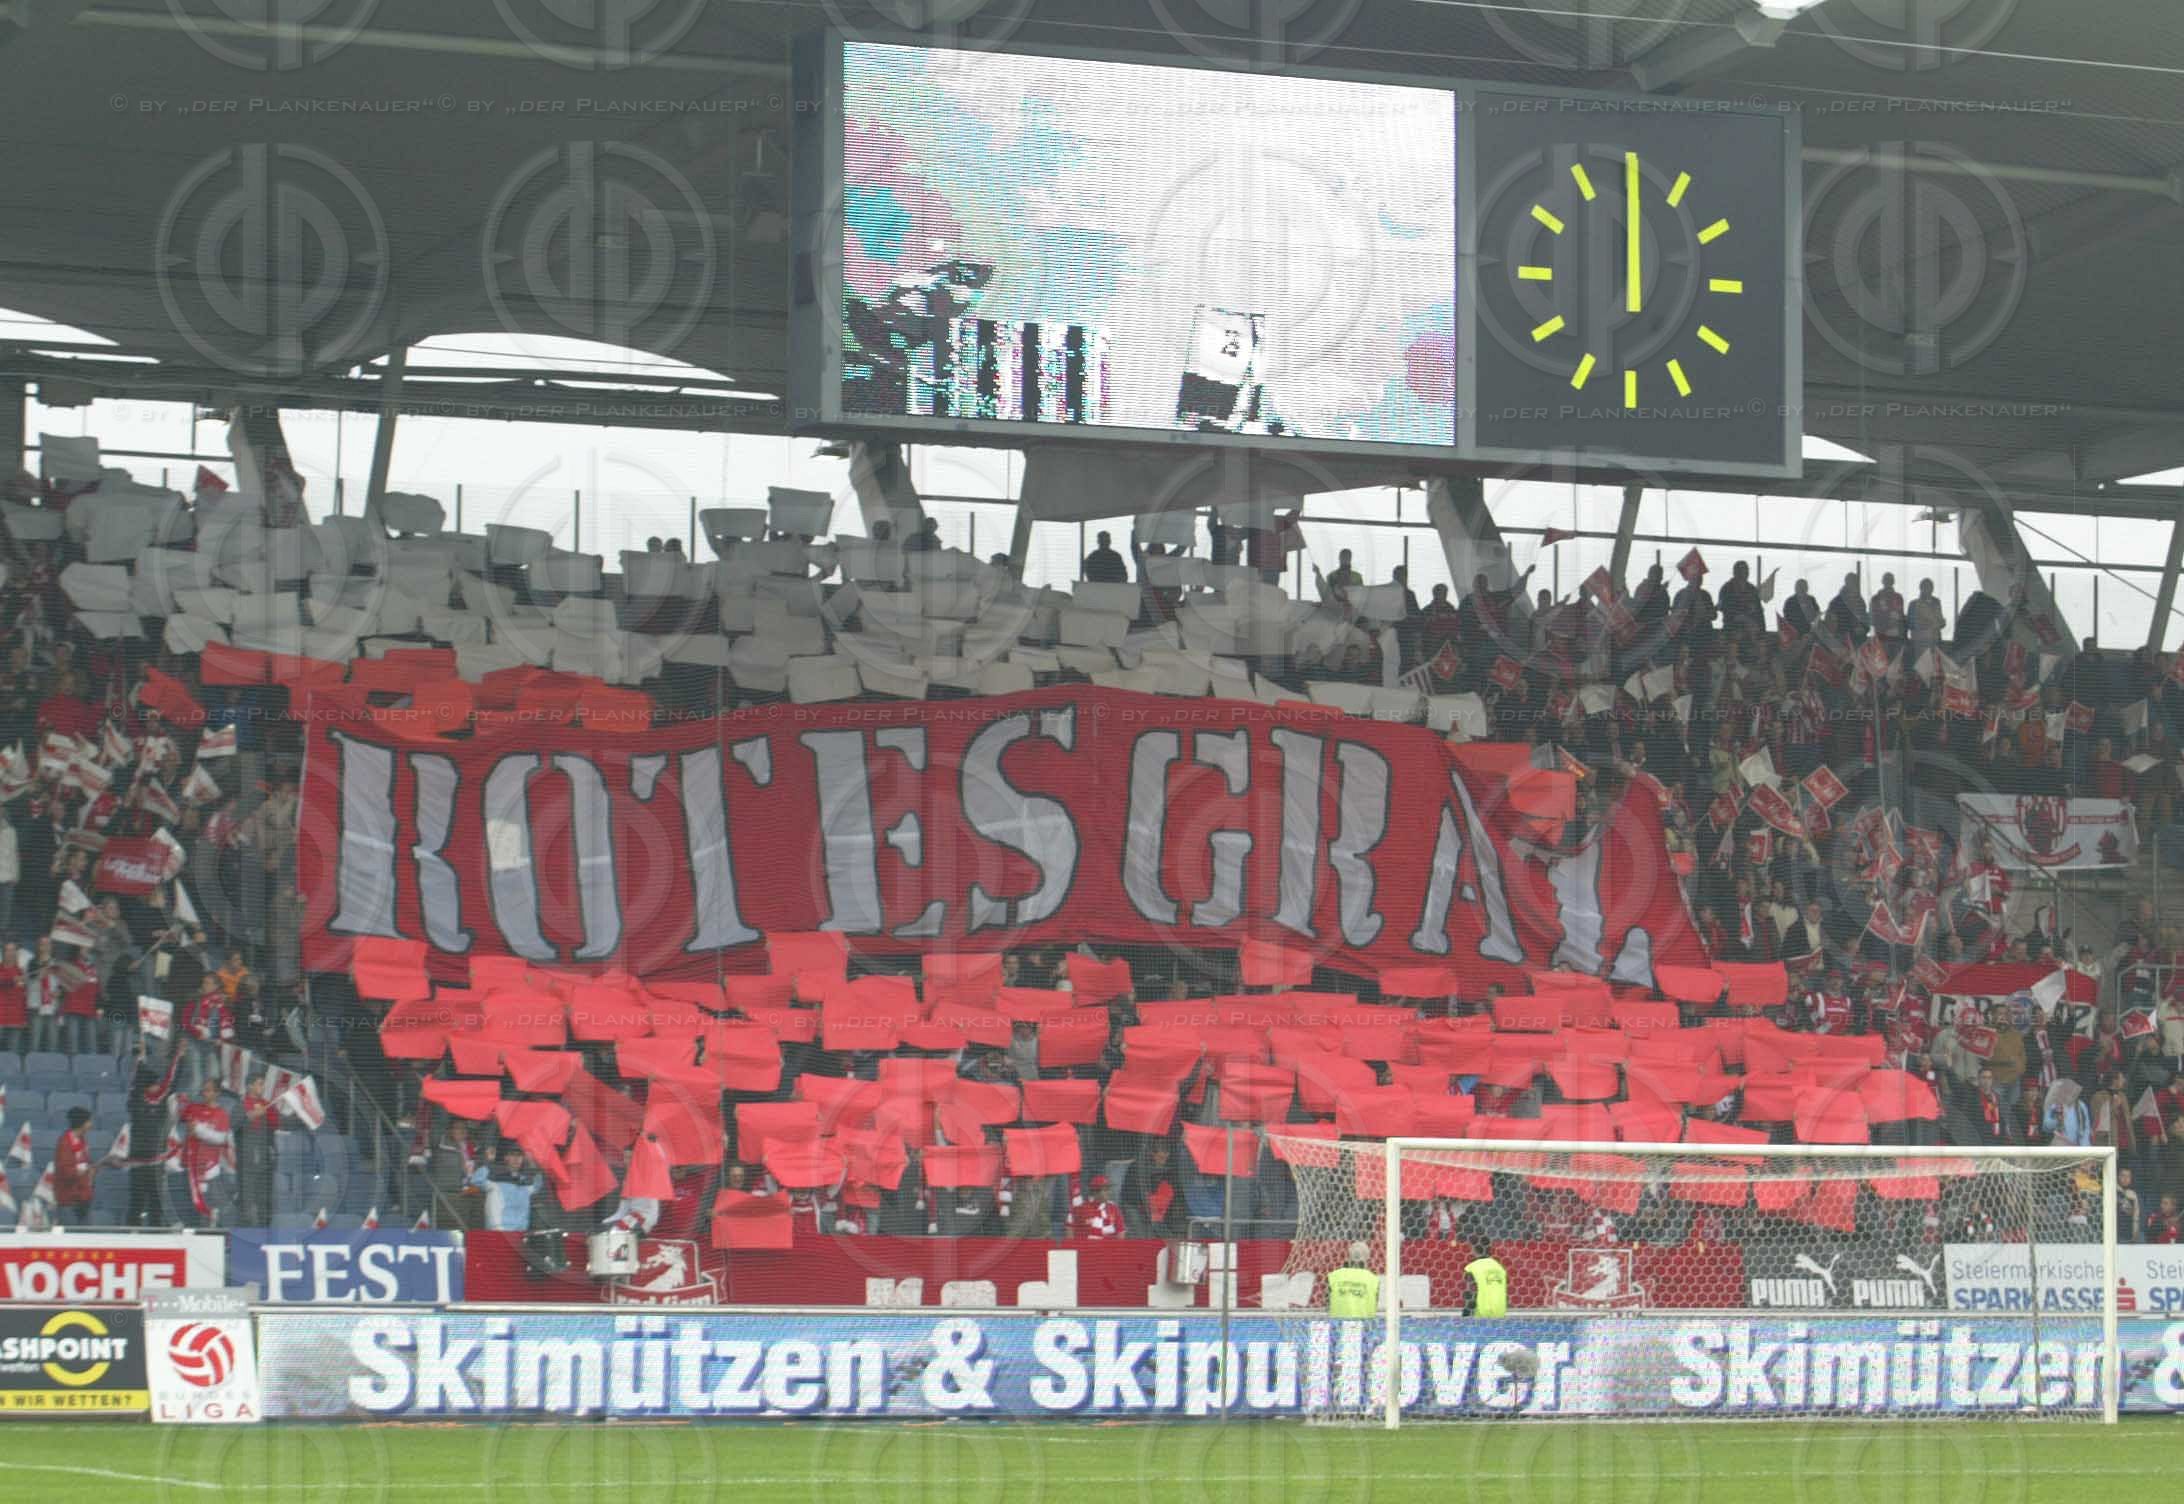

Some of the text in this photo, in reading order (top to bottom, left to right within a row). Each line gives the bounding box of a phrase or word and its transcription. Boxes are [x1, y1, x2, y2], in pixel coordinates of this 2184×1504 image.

[328, 704, 1081, 962] ROTES
[1751, 1278, 1825, 1306] PUMA
[1853, 1278, 1925, 1306] PUMA
[2149, 1287, 2184, 1311] SP
[0, 1337, 128, 1360] SHPOINT
[346, 1314, 1571, 1414] Skimützen & Skipullover
[1668, 1320, 2121, 1411] Skimützen
[160, 1402, 254, 1420] LIGA
